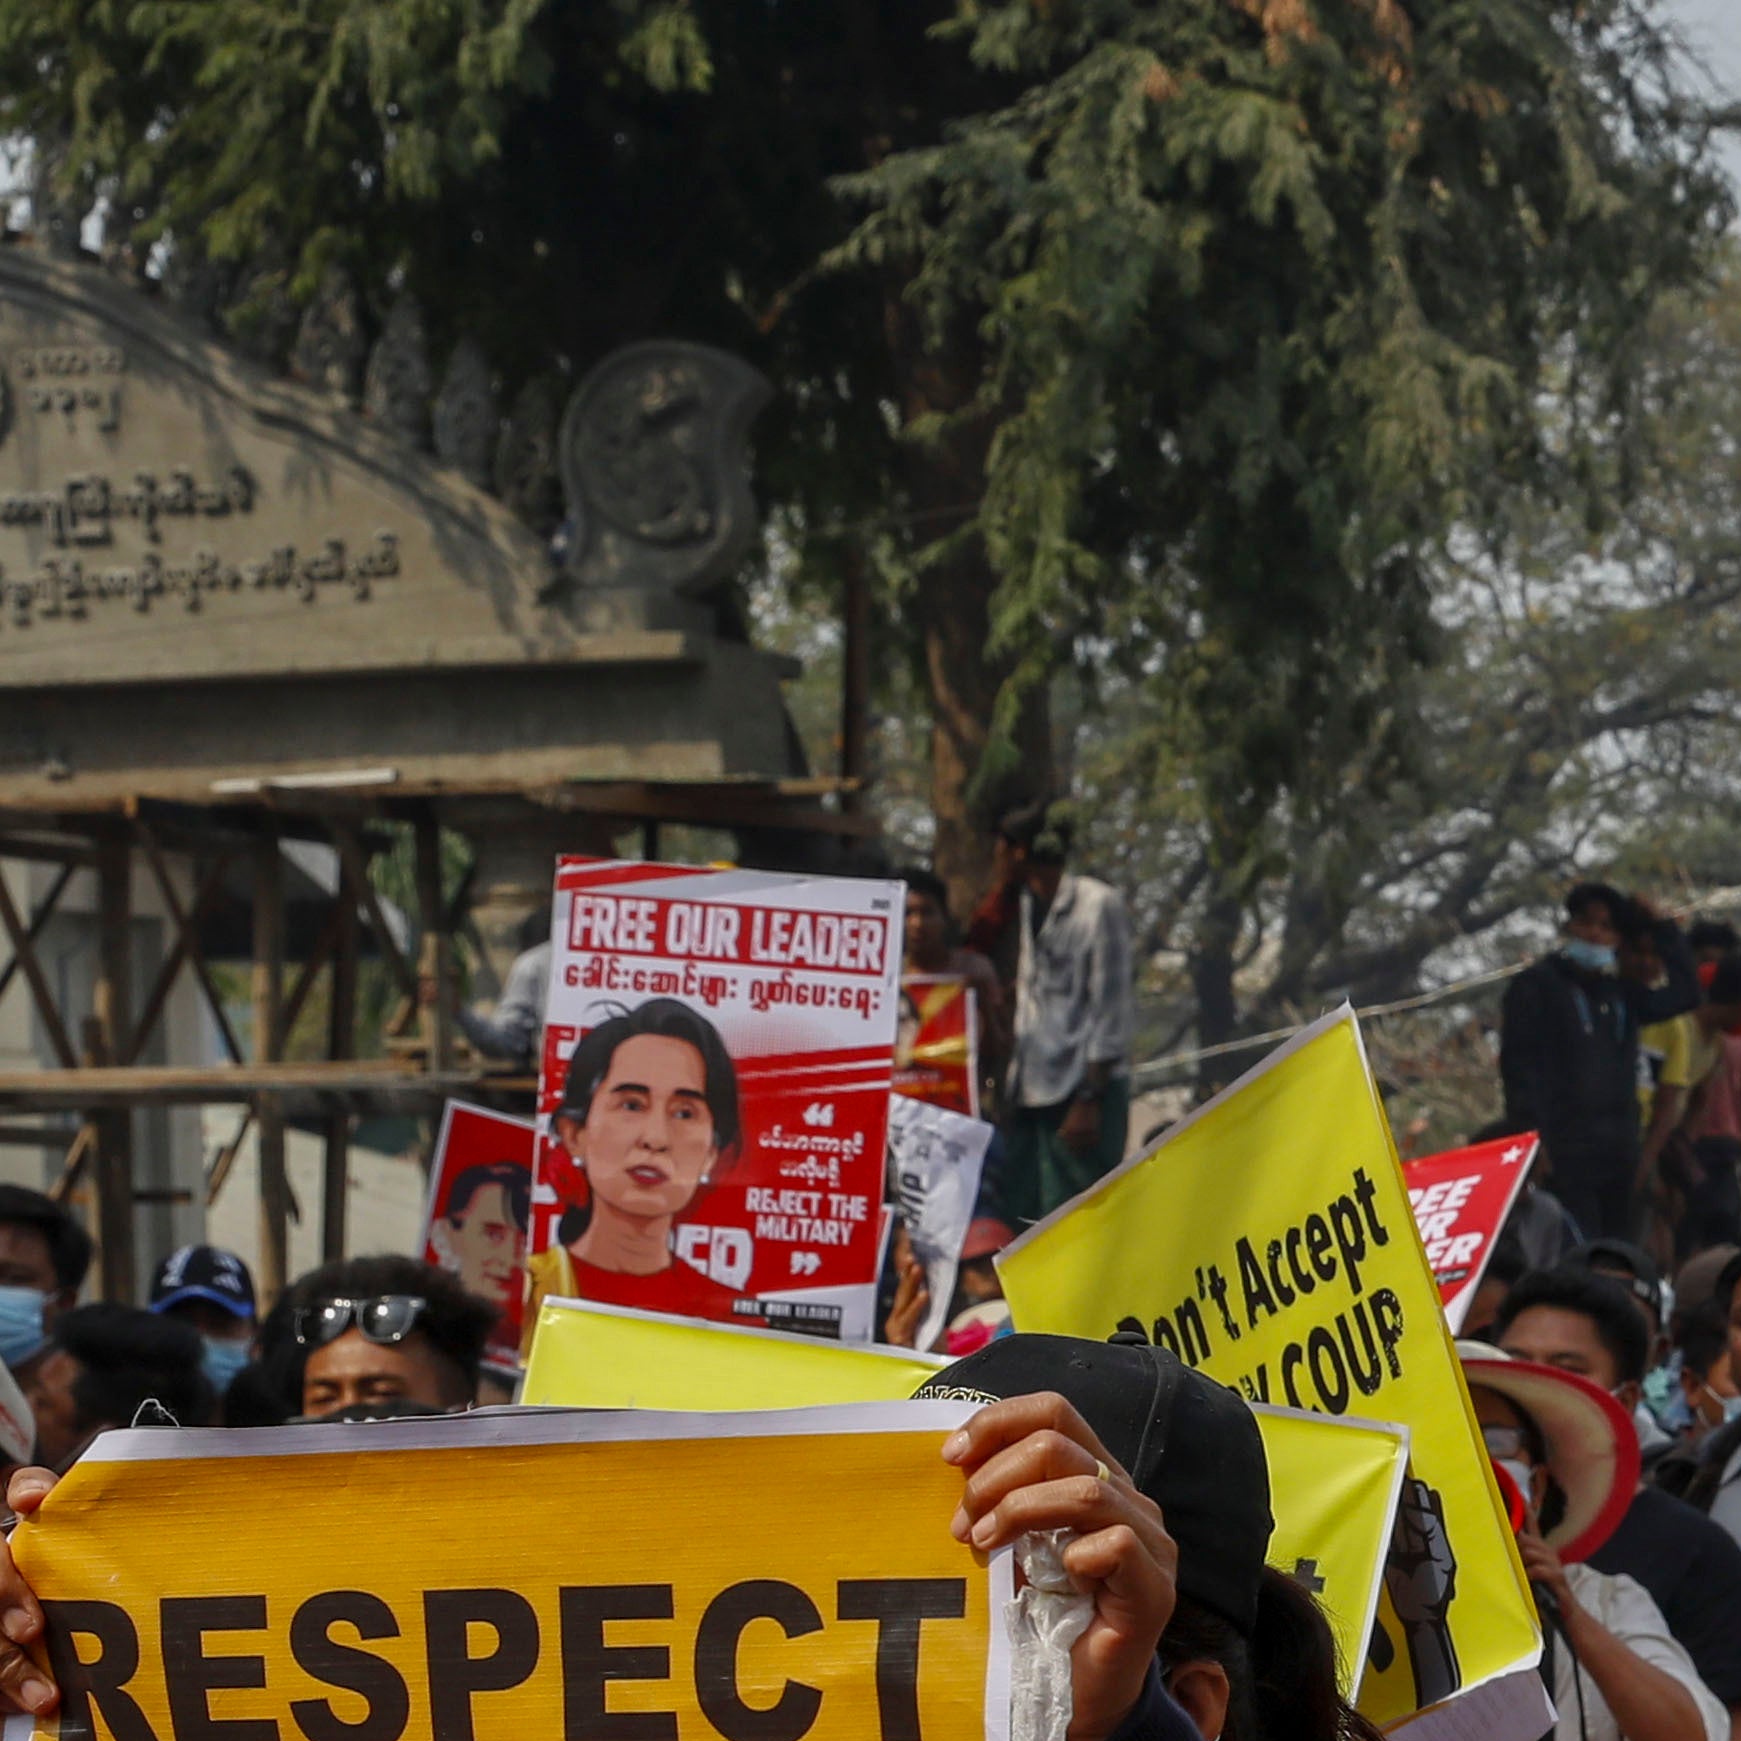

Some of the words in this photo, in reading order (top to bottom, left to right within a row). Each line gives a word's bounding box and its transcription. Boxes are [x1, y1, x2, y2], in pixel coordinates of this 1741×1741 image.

[571, 893, 659, 952] FREE
[665, 902, 741, 959] OUR
[750, 910, 885, 972] LEADER
[745, 1186, 823, 1217] REJECT
[828, 1193, 868, 1221] THE
[1235, 1167, 1389, 1330] Accept
[1282, 1288, 1403, 1415] COUP
